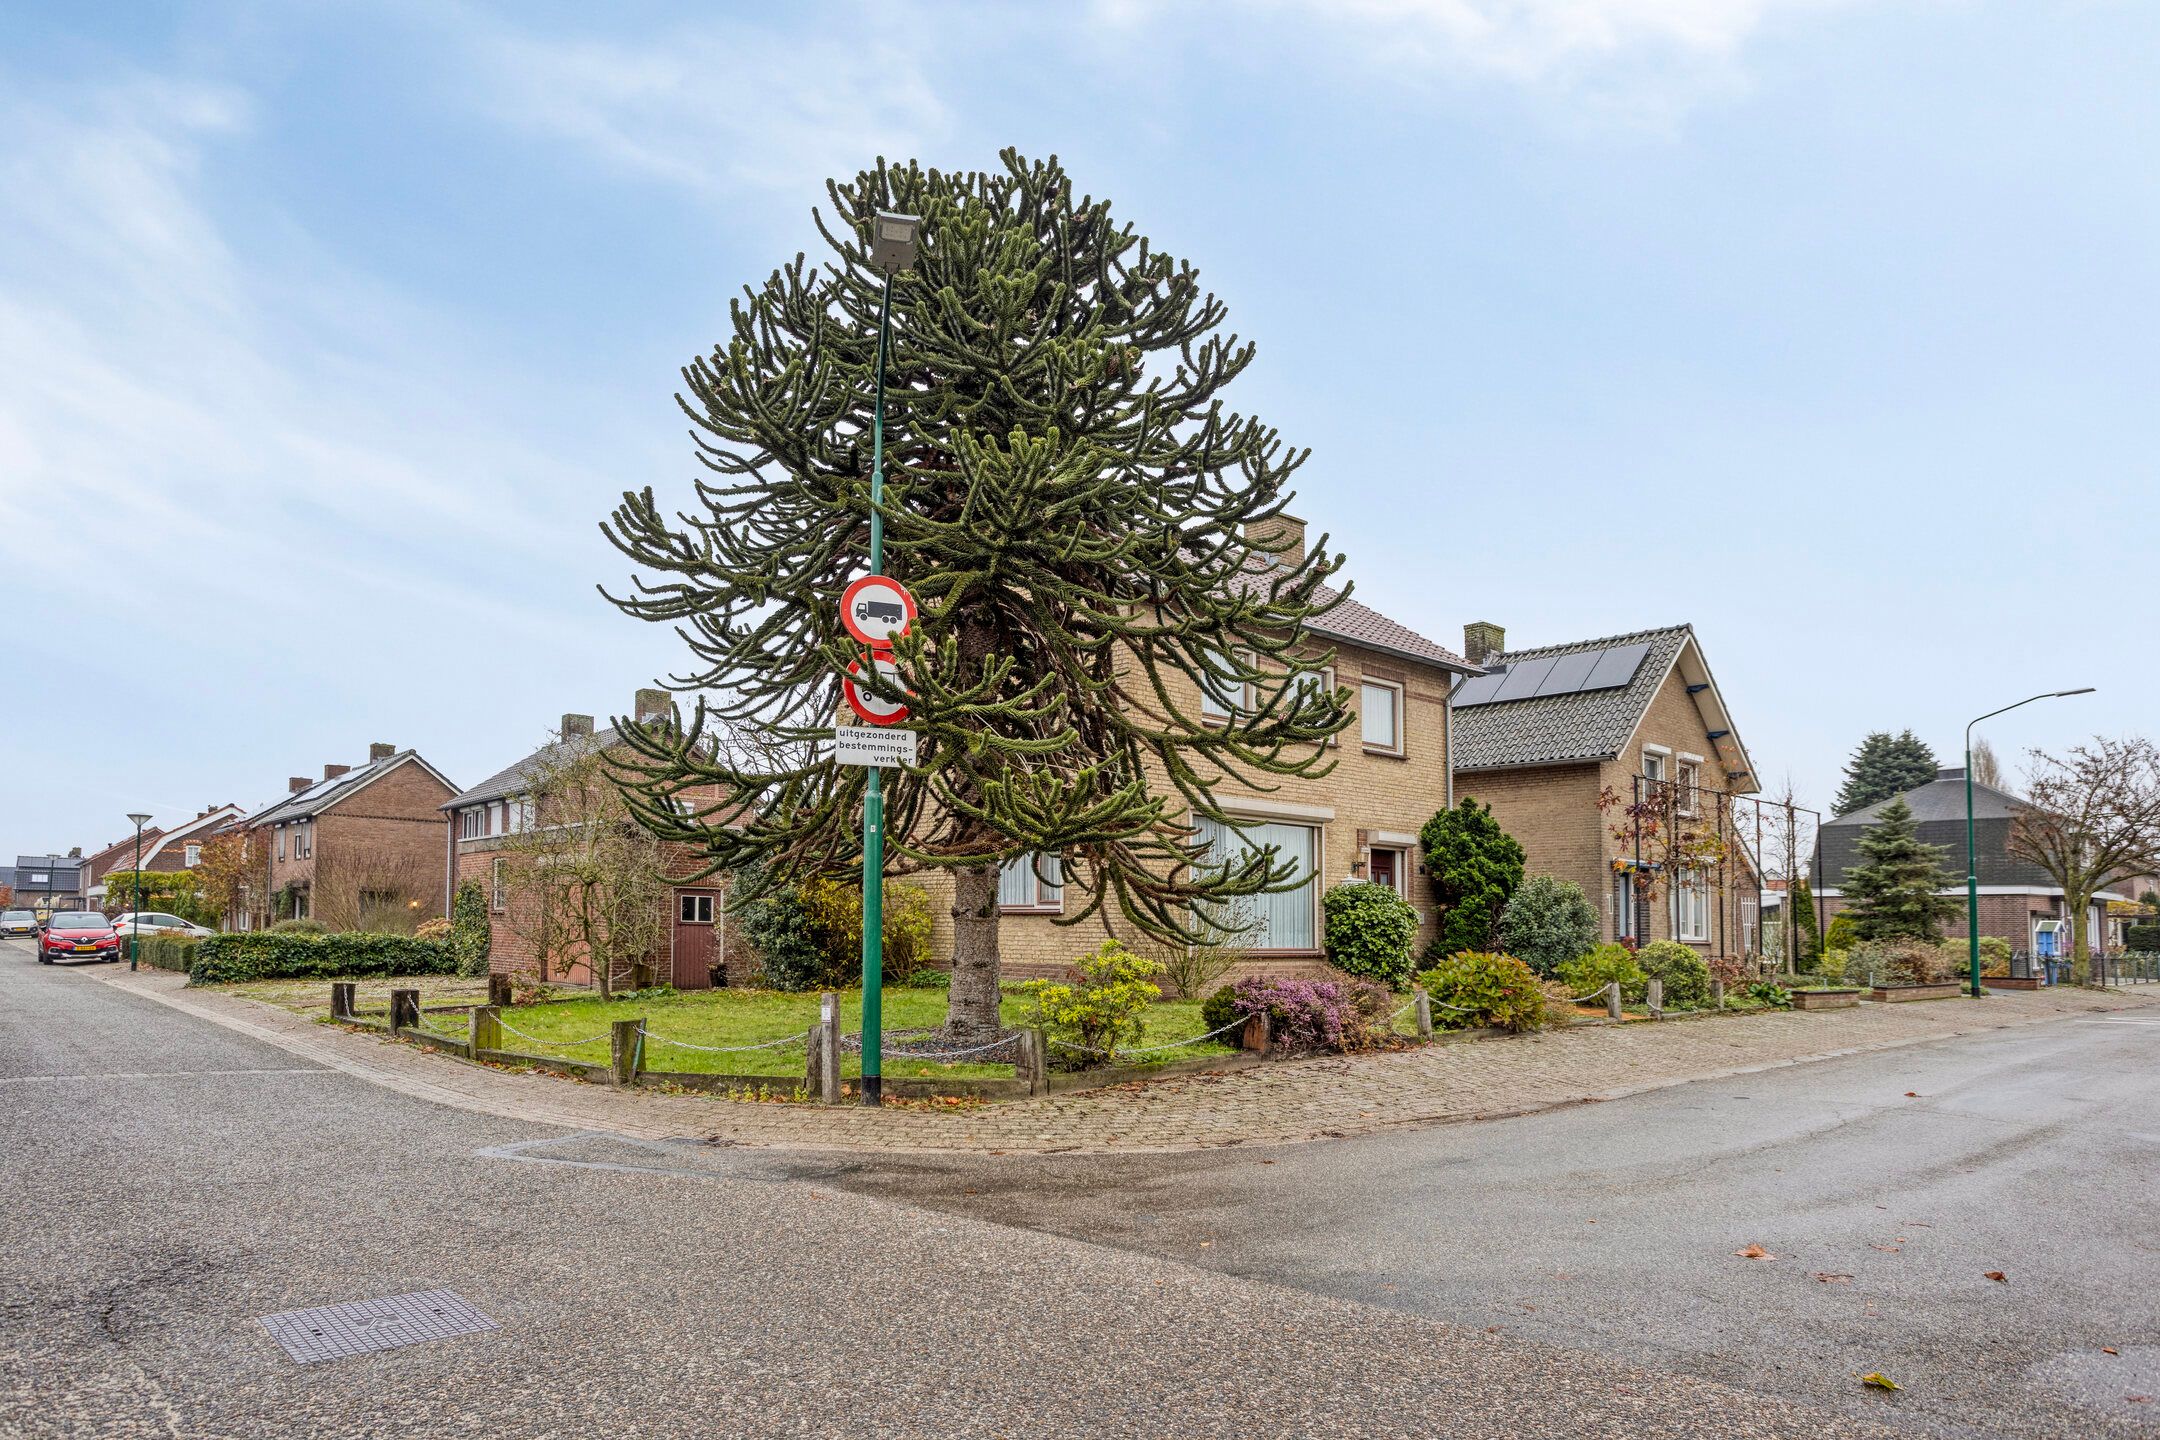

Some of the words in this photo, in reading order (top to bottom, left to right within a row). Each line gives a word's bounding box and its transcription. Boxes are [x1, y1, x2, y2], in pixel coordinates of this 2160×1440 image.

[839, 729, 907, 741] uitgezonderd
[839, 741, 913, 755] bestemmings-
[873, 755, 913, 764] verker
